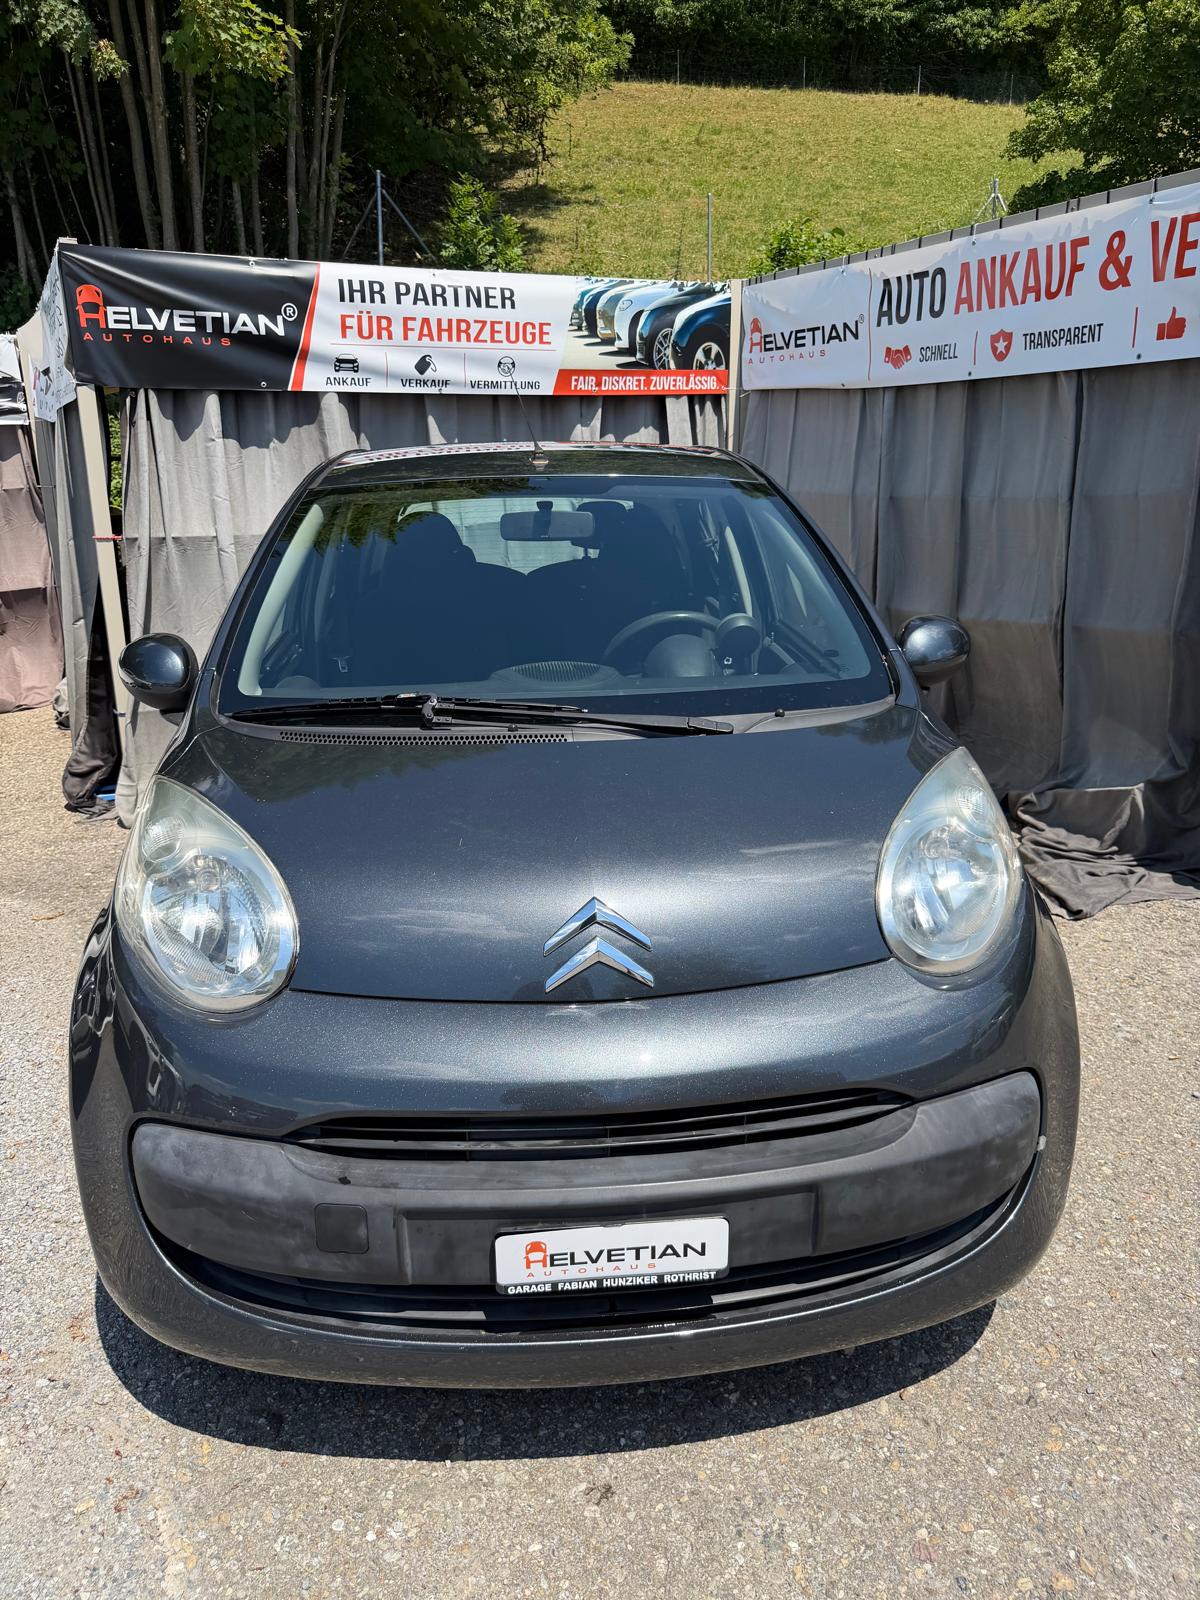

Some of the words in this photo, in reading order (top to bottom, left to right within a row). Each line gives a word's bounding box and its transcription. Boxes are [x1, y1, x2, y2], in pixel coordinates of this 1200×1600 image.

[876, 267, 947, 328] AUTO
[954, 236, 1090, 316] ANKAUF
[1098, 230, 1134, 292] &
[338, 278, 387, 305] IHR
[394, 281, 517, 310] PARTNER
[340, 309, 394, 341] FÜR
[402, 316, 552, 345] FAHRZEUGE
[83, 332, 232, 347] AUTOHAUS
[1022, 323, 1104, 351] TRANSPARENT
[748, 350, 826, 364] AUTOHAUS
[919, 343, 959, 363] SCHNELL
[325, 376, 372, 387] ANKAUF
[400, 378, 451, 389] VERKAUF
[470, 379, 541, 390] VERMITTLUNG
[602, 376, 648, 391] DISKRET.
[650, 374, 719, 390] ZUVERLÄSSIG.
[524, 1241, 707, 1270] HELVETIAN
[527, 1263, 657, 1278] AUTOHAUS
[507, 1283, 552, 1295] GARAGE
[558, 1279, 597, 1291] FABIAN
[603, 1275, 658, 1287] HUNZIKER
[664, 1271, 717, 1283] ROTHRIST
